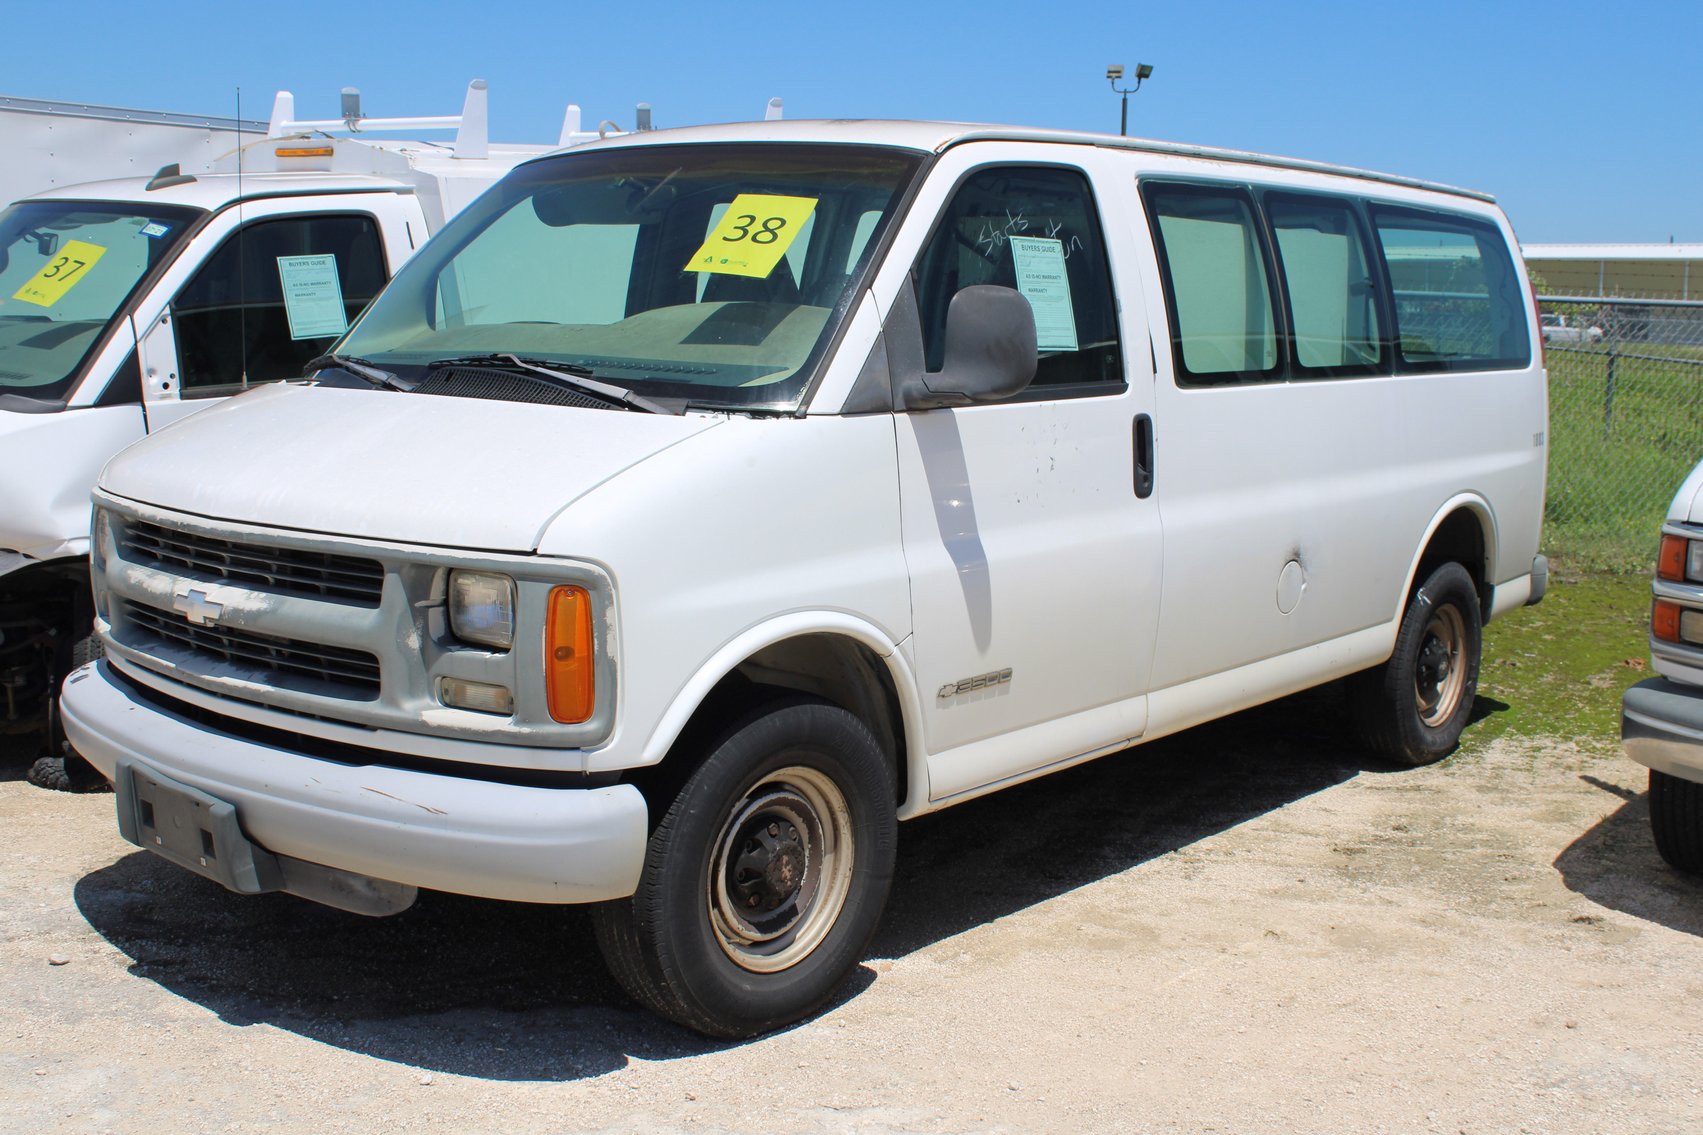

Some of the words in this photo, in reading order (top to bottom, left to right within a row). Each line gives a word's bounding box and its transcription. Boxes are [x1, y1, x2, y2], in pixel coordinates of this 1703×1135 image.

[722, 214, 787, 245] 38
[1021, 244, 1040, 252] BUYERS
[1041, 246, 1056, 254] GUIDE
[43, 256, 86, 282] 37
